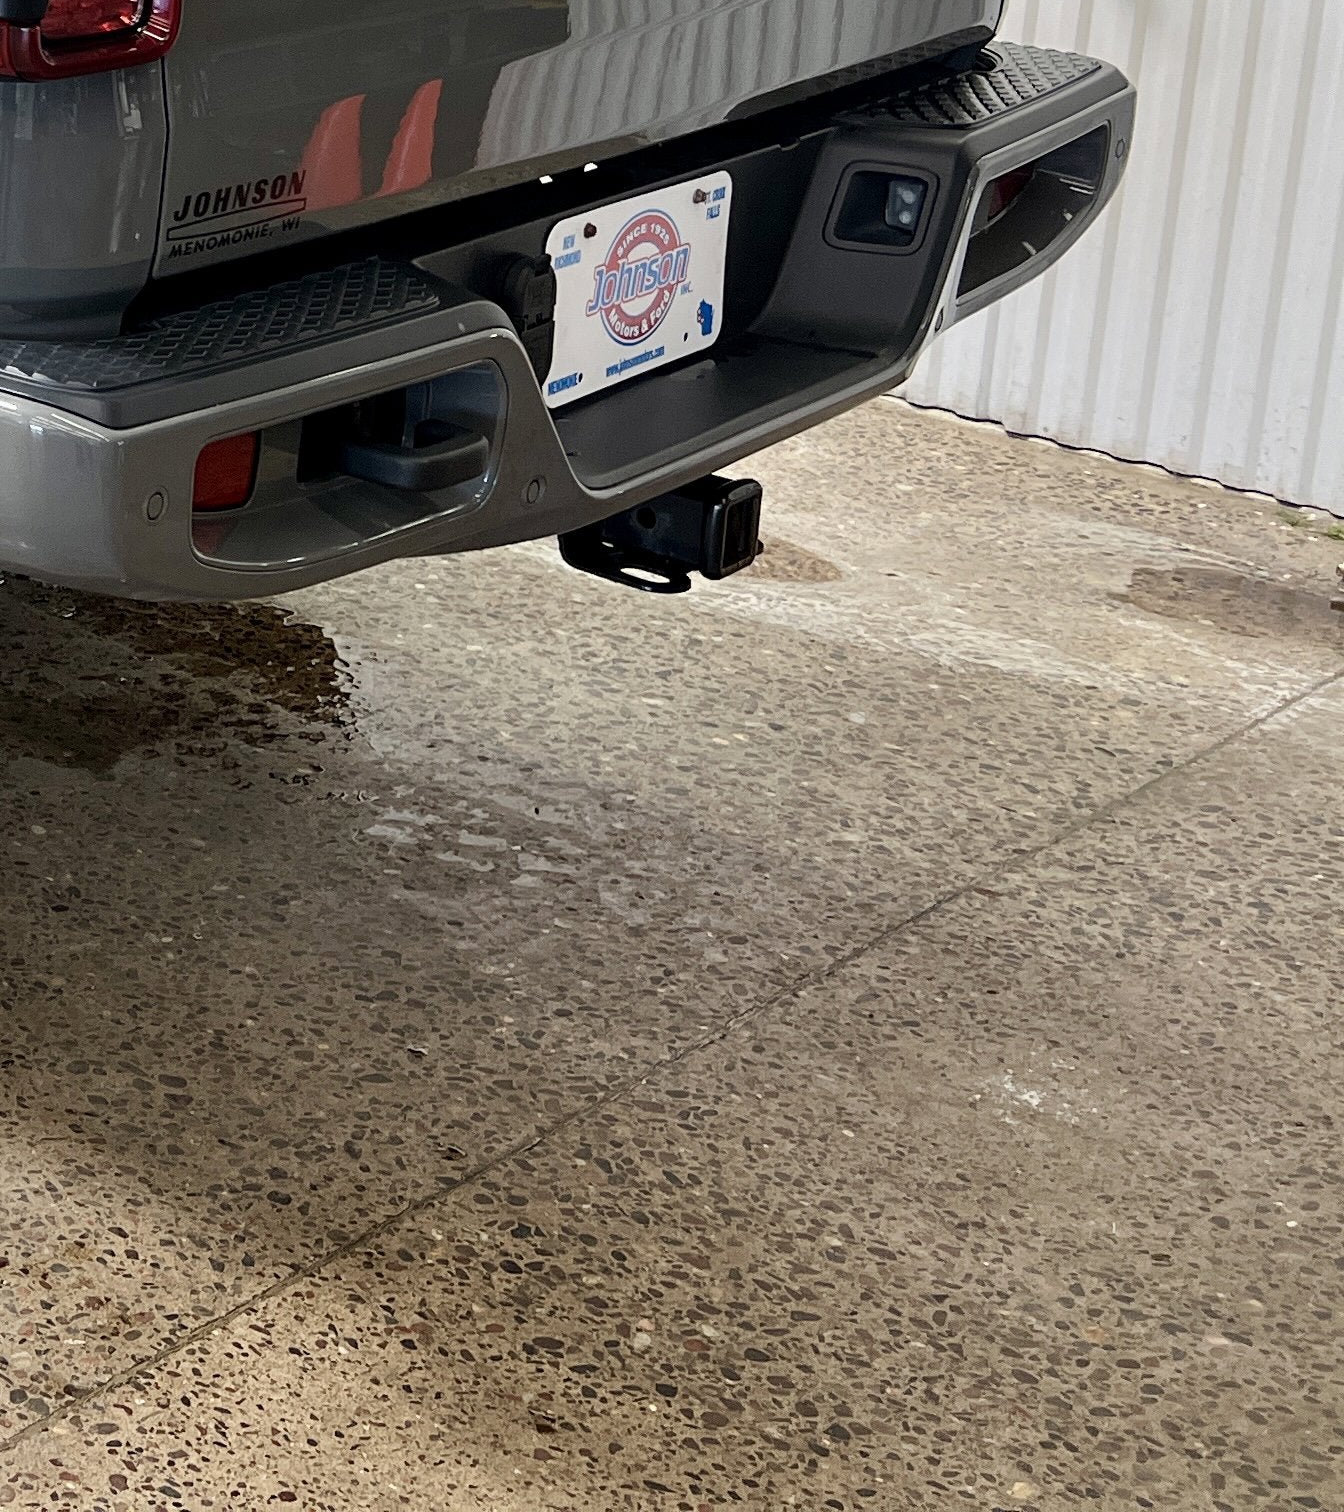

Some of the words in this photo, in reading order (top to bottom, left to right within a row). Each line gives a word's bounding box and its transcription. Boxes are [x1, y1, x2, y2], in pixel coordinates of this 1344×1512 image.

[173, 170, 307, 222] JOHNSON
[168, 223, 273, 259] MENOMONIE,
[281, 216, 301, 233] WI
[616, 224, 648, 258] SINCE
[587, 245, 690, 315] Johnson
[609, 308, 640, 338] Motors
[641, 321, 649, 334] &
[650, 289, 671, 326] Ford
